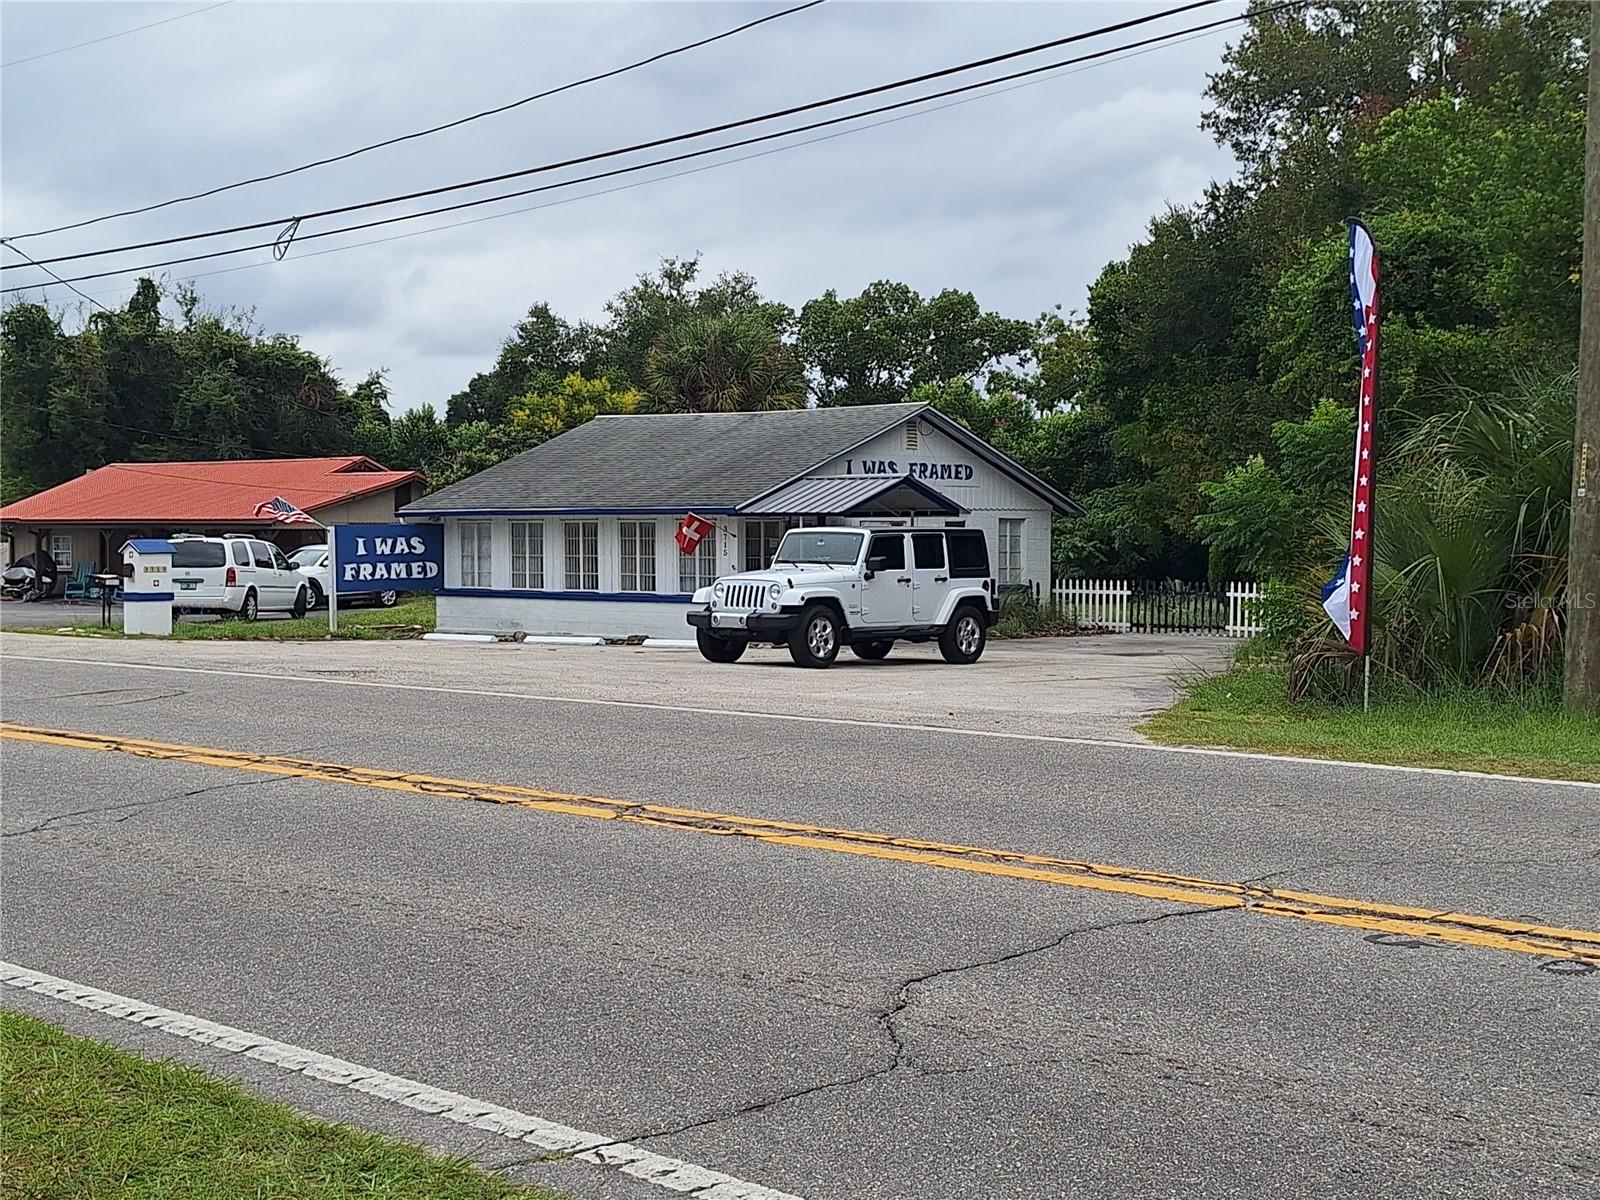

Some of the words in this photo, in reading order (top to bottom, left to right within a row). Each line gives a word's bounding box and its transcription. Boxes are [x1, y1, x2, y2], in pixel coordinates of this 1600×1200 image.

[844, 459, 854, 475] I
[862, 460, 899, 475] WAS
[908, 462, 974, 481] FRAMED
[355, 537, 368, 556] I
[374, 536, 426, 556] WAS
[343, 561, 439, 581] FRAMED
